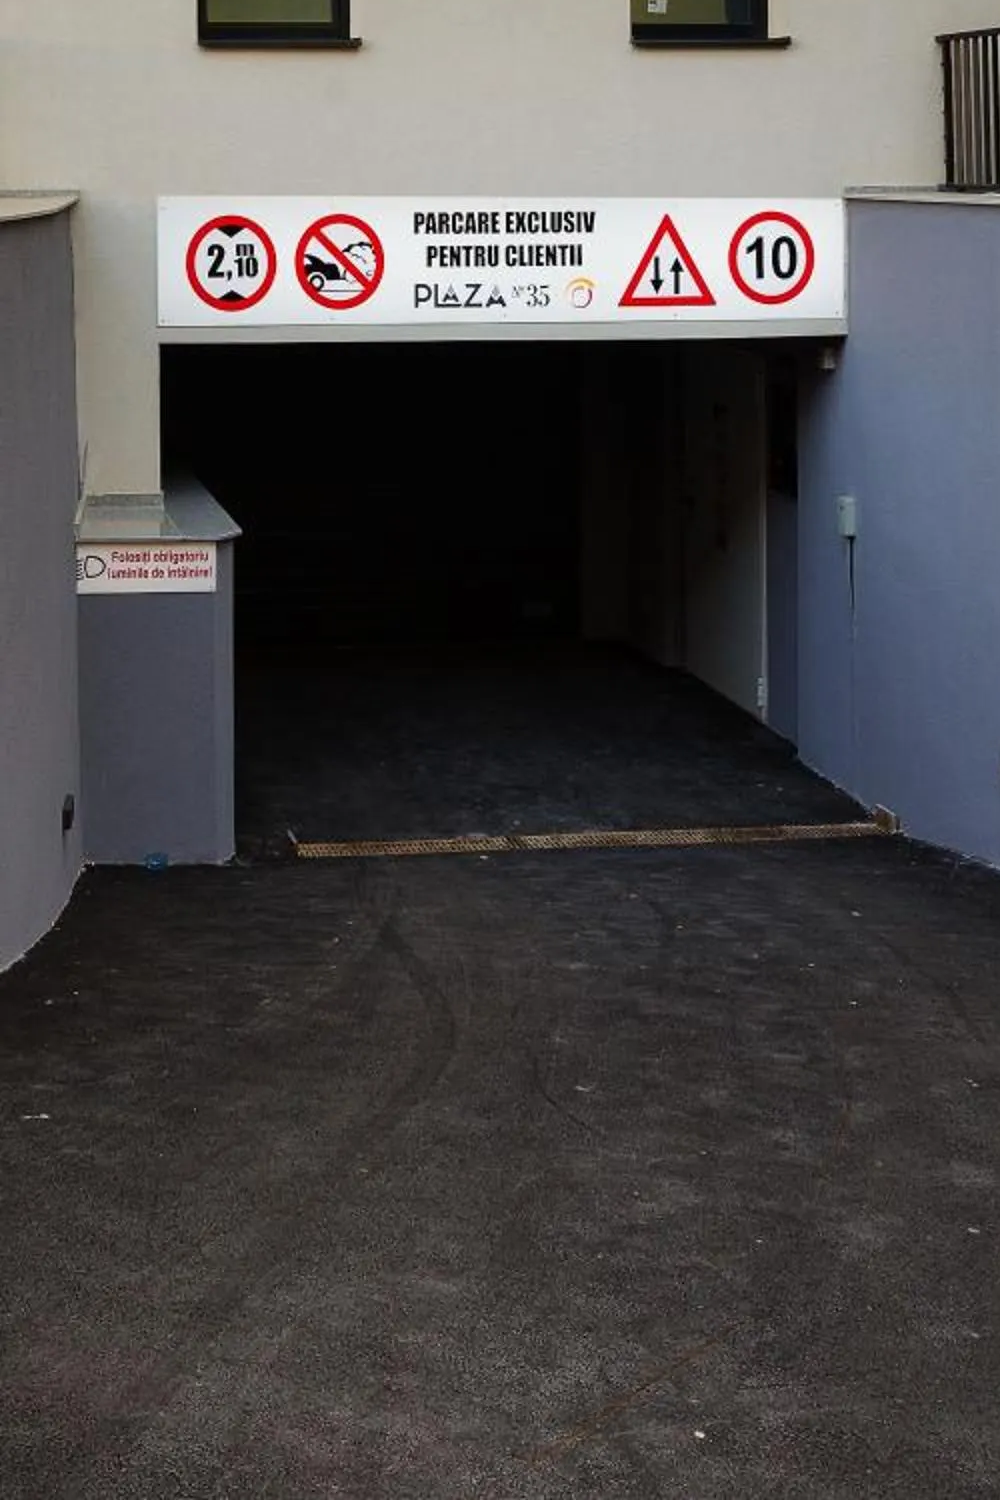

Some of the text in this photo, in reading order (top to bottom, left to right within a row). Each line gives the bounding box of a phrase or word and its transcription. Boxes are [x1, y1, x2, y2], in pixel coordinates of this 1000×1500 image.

[413, 211, 596, 234] PARCARE EXCLUSIV
[426, 244, 583, 267] PENTRU CLIENTII
[746, 236, 797, 279] 10
[414, 283, 507, 309] PLAZA
[151, 568, 165, 578] de
